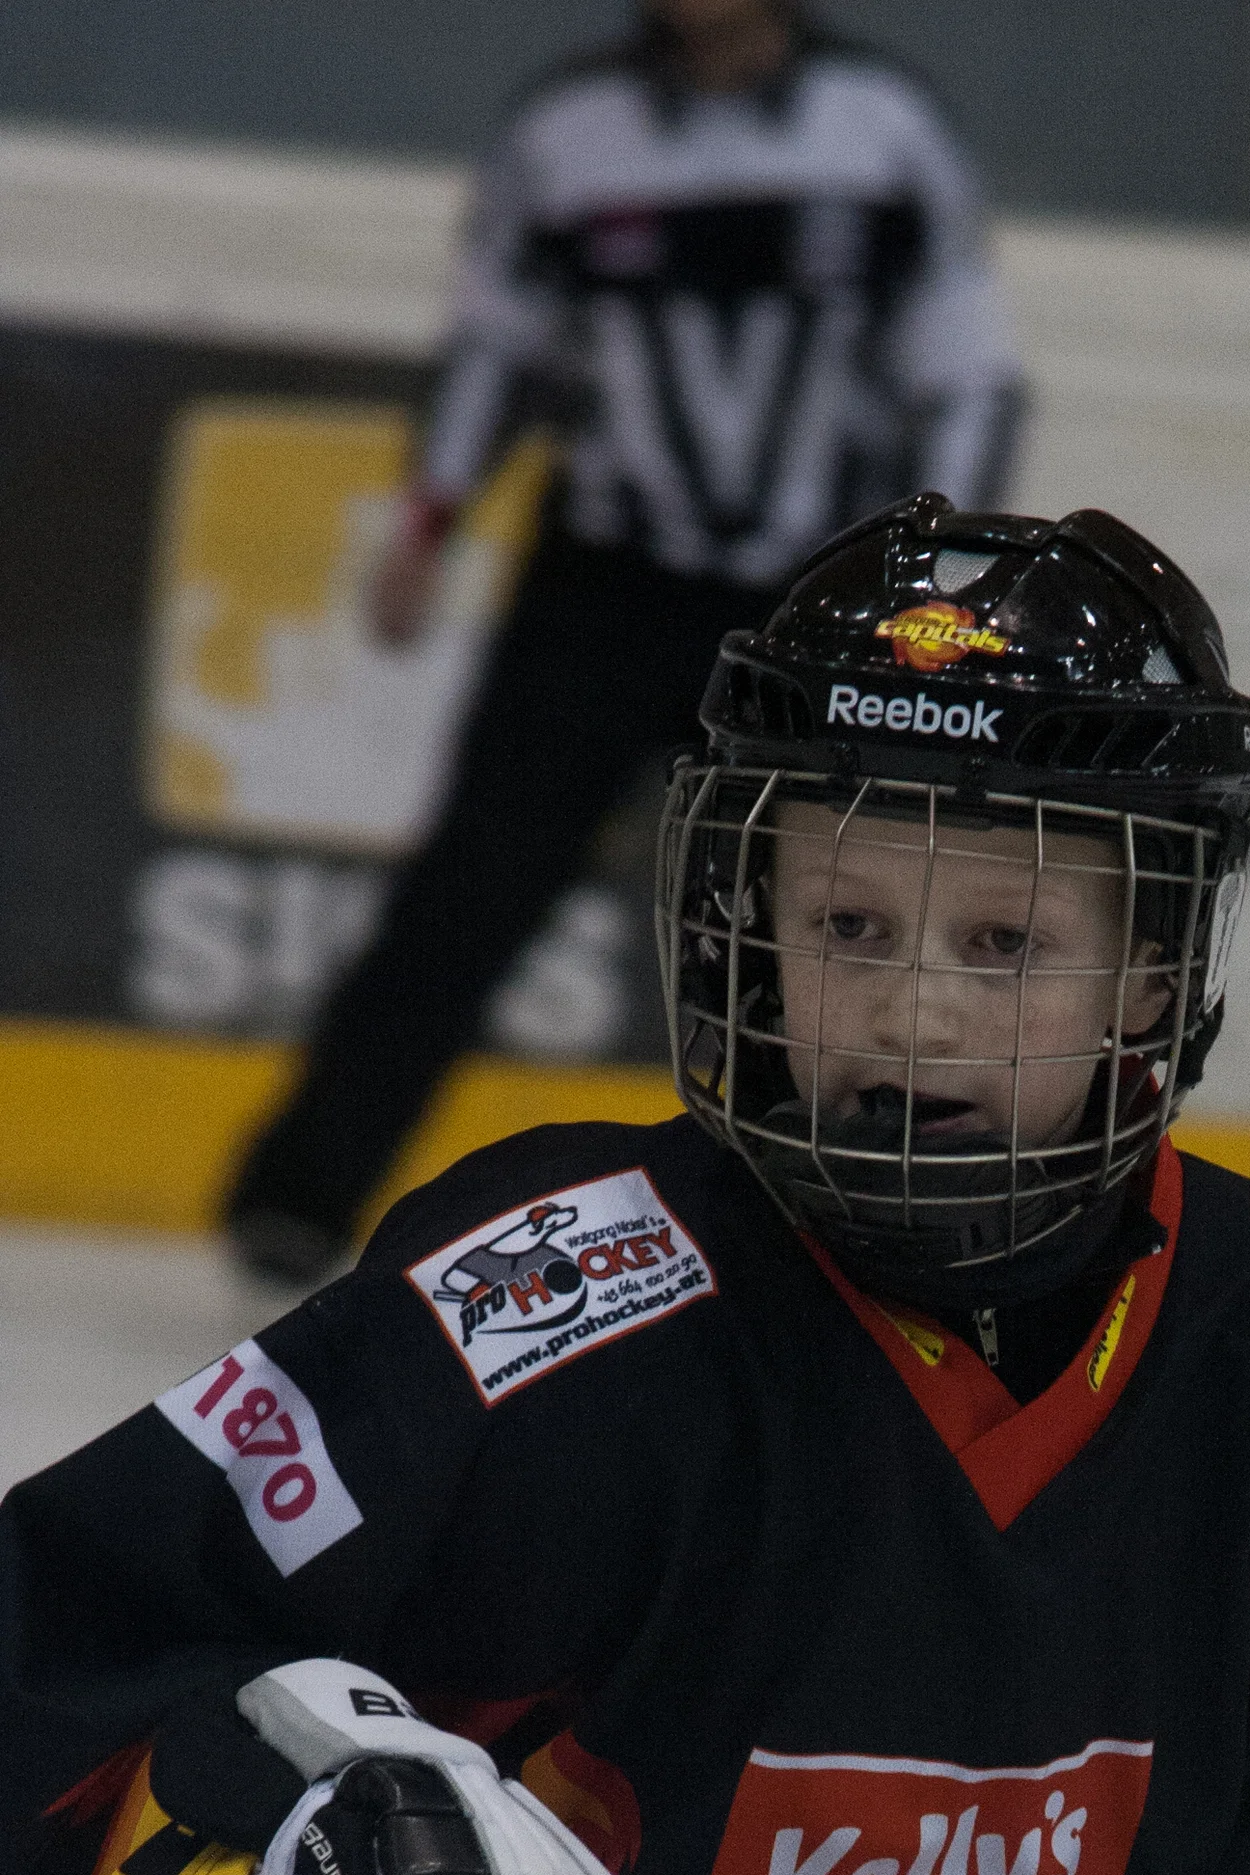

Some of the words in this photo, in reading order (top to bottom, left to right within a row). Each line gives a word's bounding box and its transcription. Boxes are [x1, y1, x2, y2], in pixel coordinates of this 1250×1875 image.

[826, 683, 1003, 743] Reebok
[480, 1268, 707, 1390] www.prohockey.at
[193, 1355, 317, 1523] 1870
